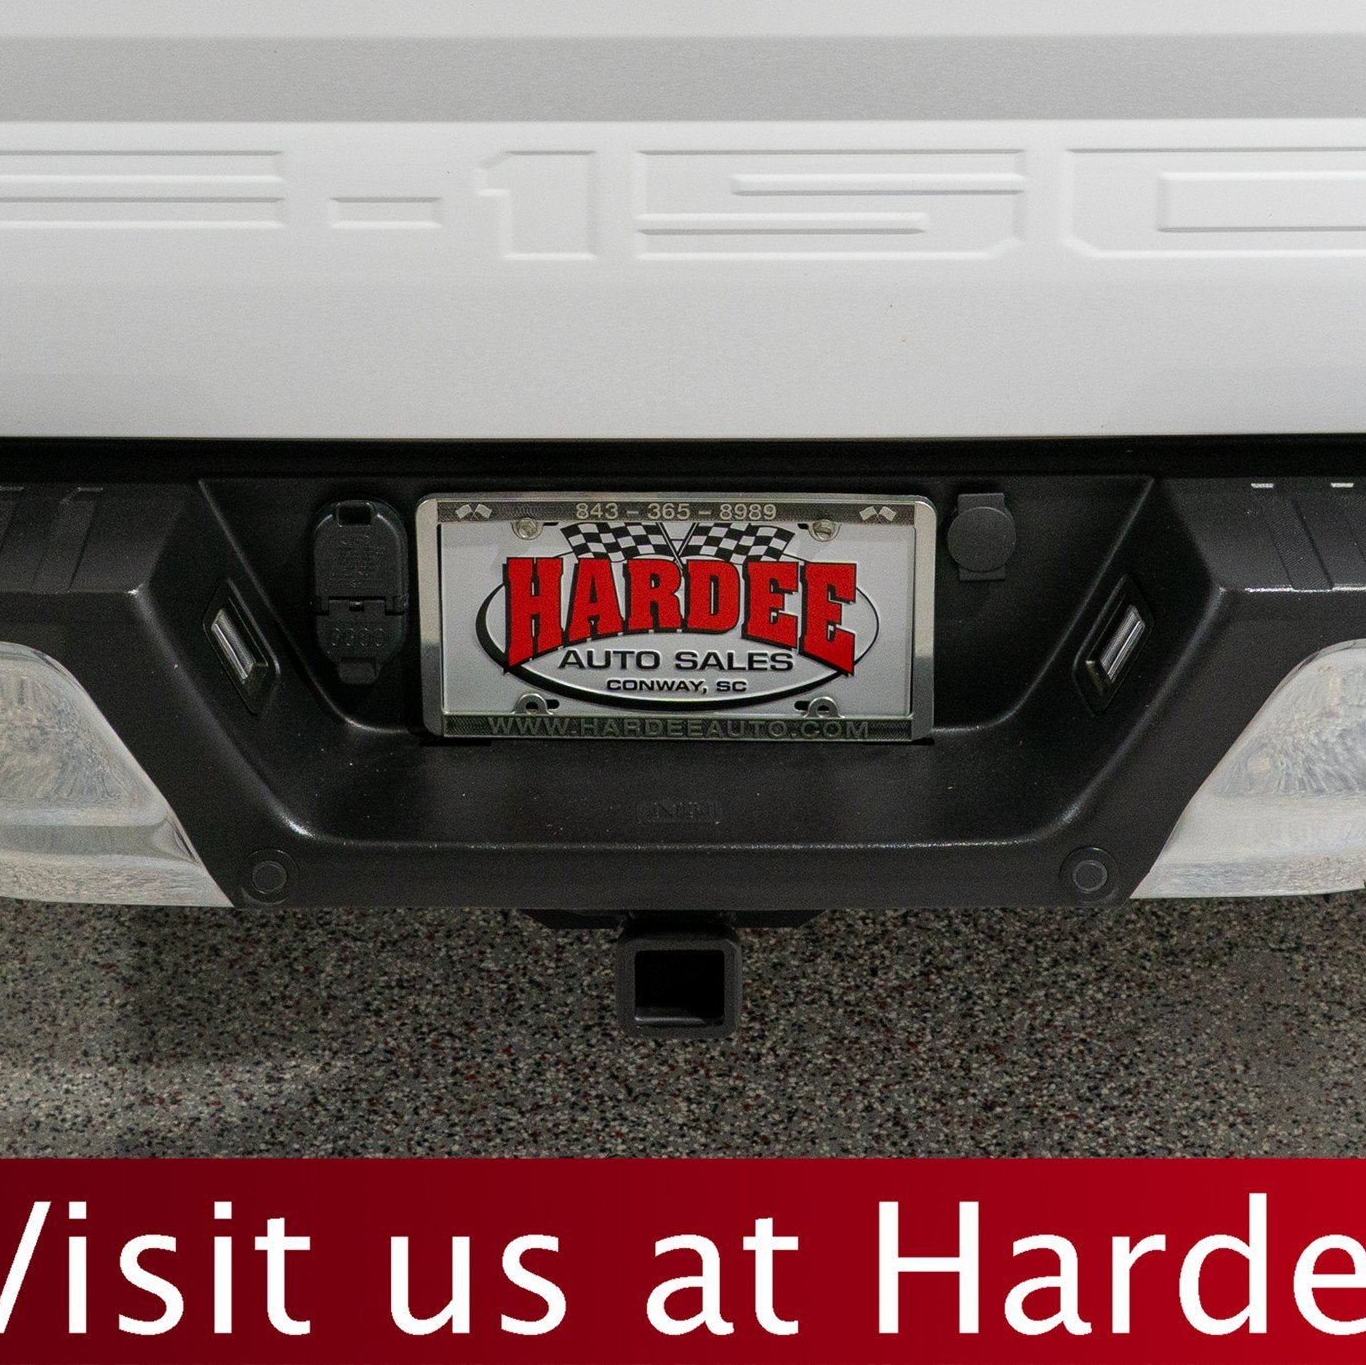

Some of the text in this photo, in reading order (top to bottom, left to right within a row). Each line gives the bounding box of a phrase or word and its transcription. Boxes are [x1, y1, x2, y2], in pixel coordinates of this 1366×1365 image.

[576, 502, 619, 520] 843
[647, 503, 691, 520] 365
[719, 503, 777, 520] 8989
[503, 557, 857, 676] HARDEE
[558, 650, 794, 672] AUTO SALES
[606, 679, 748, 694] CONWAY, SC
[487, 716, 870, 739] WWW.HARDEEAUTO.COM
